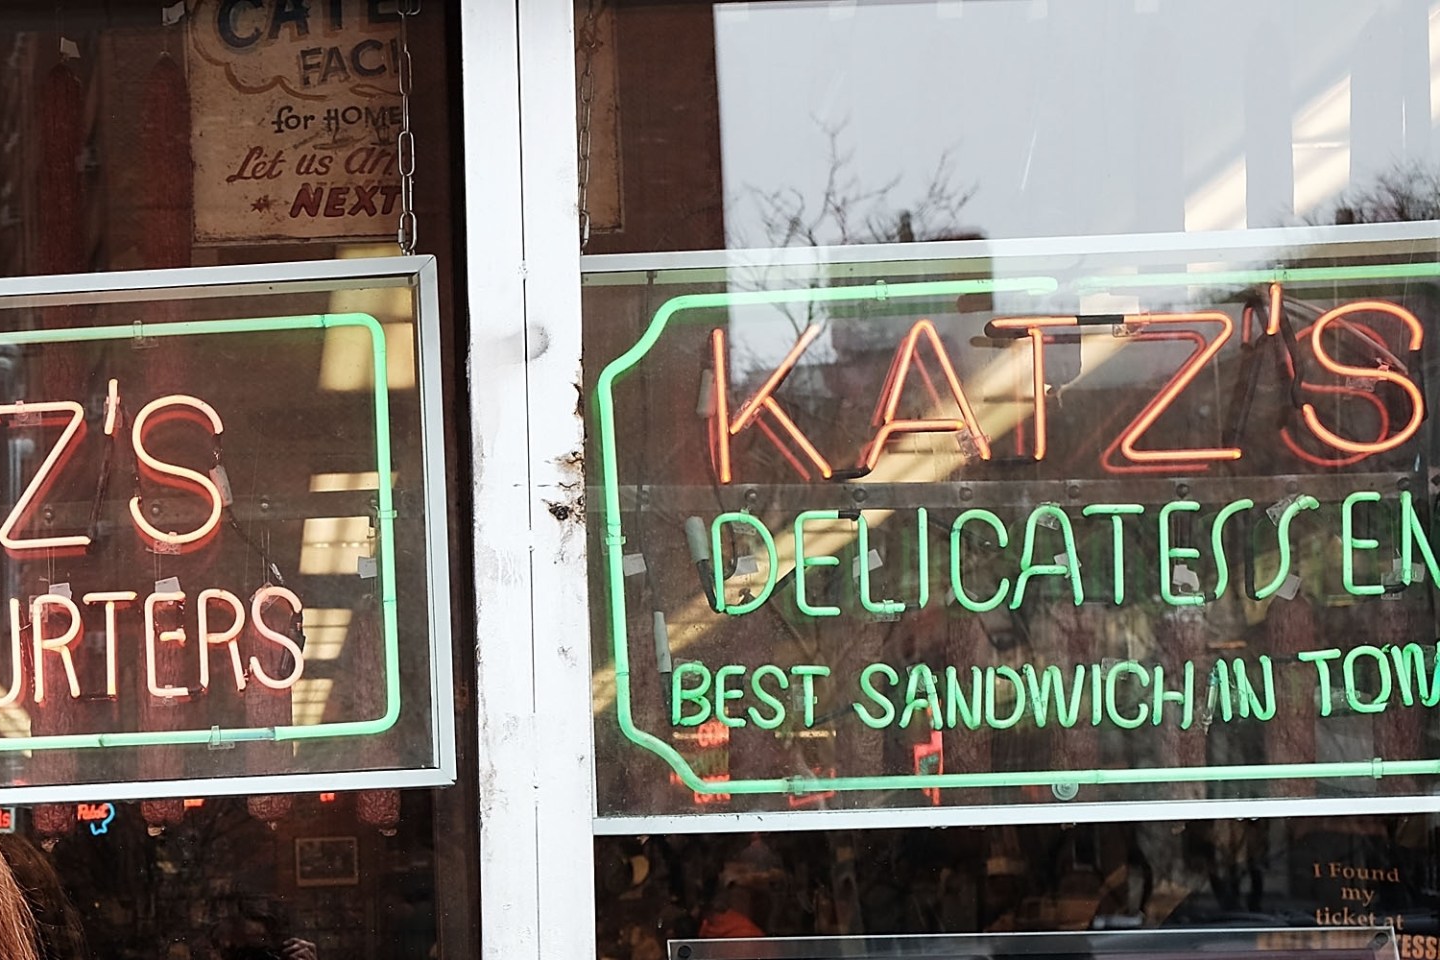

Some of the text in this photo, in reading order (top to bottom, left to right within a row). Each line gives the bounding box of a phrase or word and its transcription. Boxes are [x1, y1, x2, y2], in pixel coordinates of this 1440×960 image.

[271, 105, 315, 133] for
[226, 146, 287, 183] Let
[295, 153, 334, 176] us
[289, 182, 402, 218] NEXT
[712, 281, 1423, 484] KATZ'S
[712, 490, 1440, 616] DELICATESSEN
[672, 662, 831, 730] BEST
[853, 659, 1194, 731] SANDWICH
[1216, 655, 1277, 723] IN
[1313, 861, 1400, 883] I Found
[1341, 886, 1375, 907] my
[1316, 906, 1376, 926] ticket
